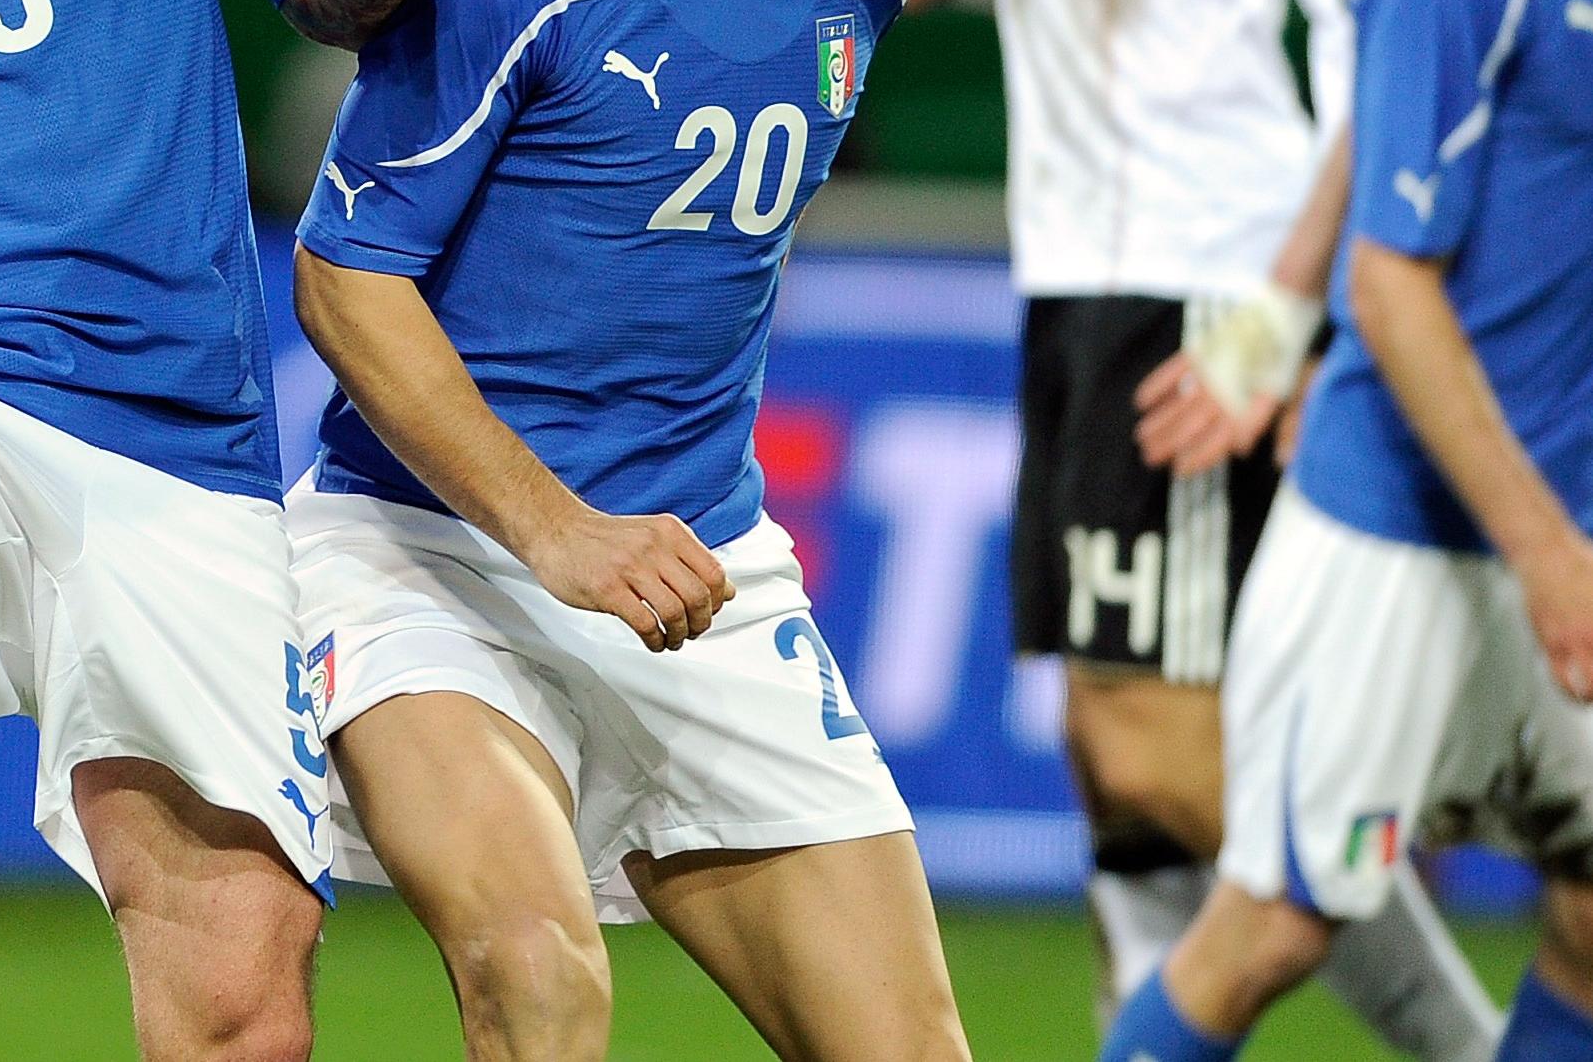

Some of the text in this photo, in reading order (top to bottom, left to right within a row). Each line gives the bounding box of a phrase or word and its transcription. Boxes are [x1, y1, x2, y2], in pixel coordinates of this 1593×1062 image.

[646, 103, 808, 236] 20
[1062, 524, 1163, 657] 14
[774, 616, 870, 740] 2
